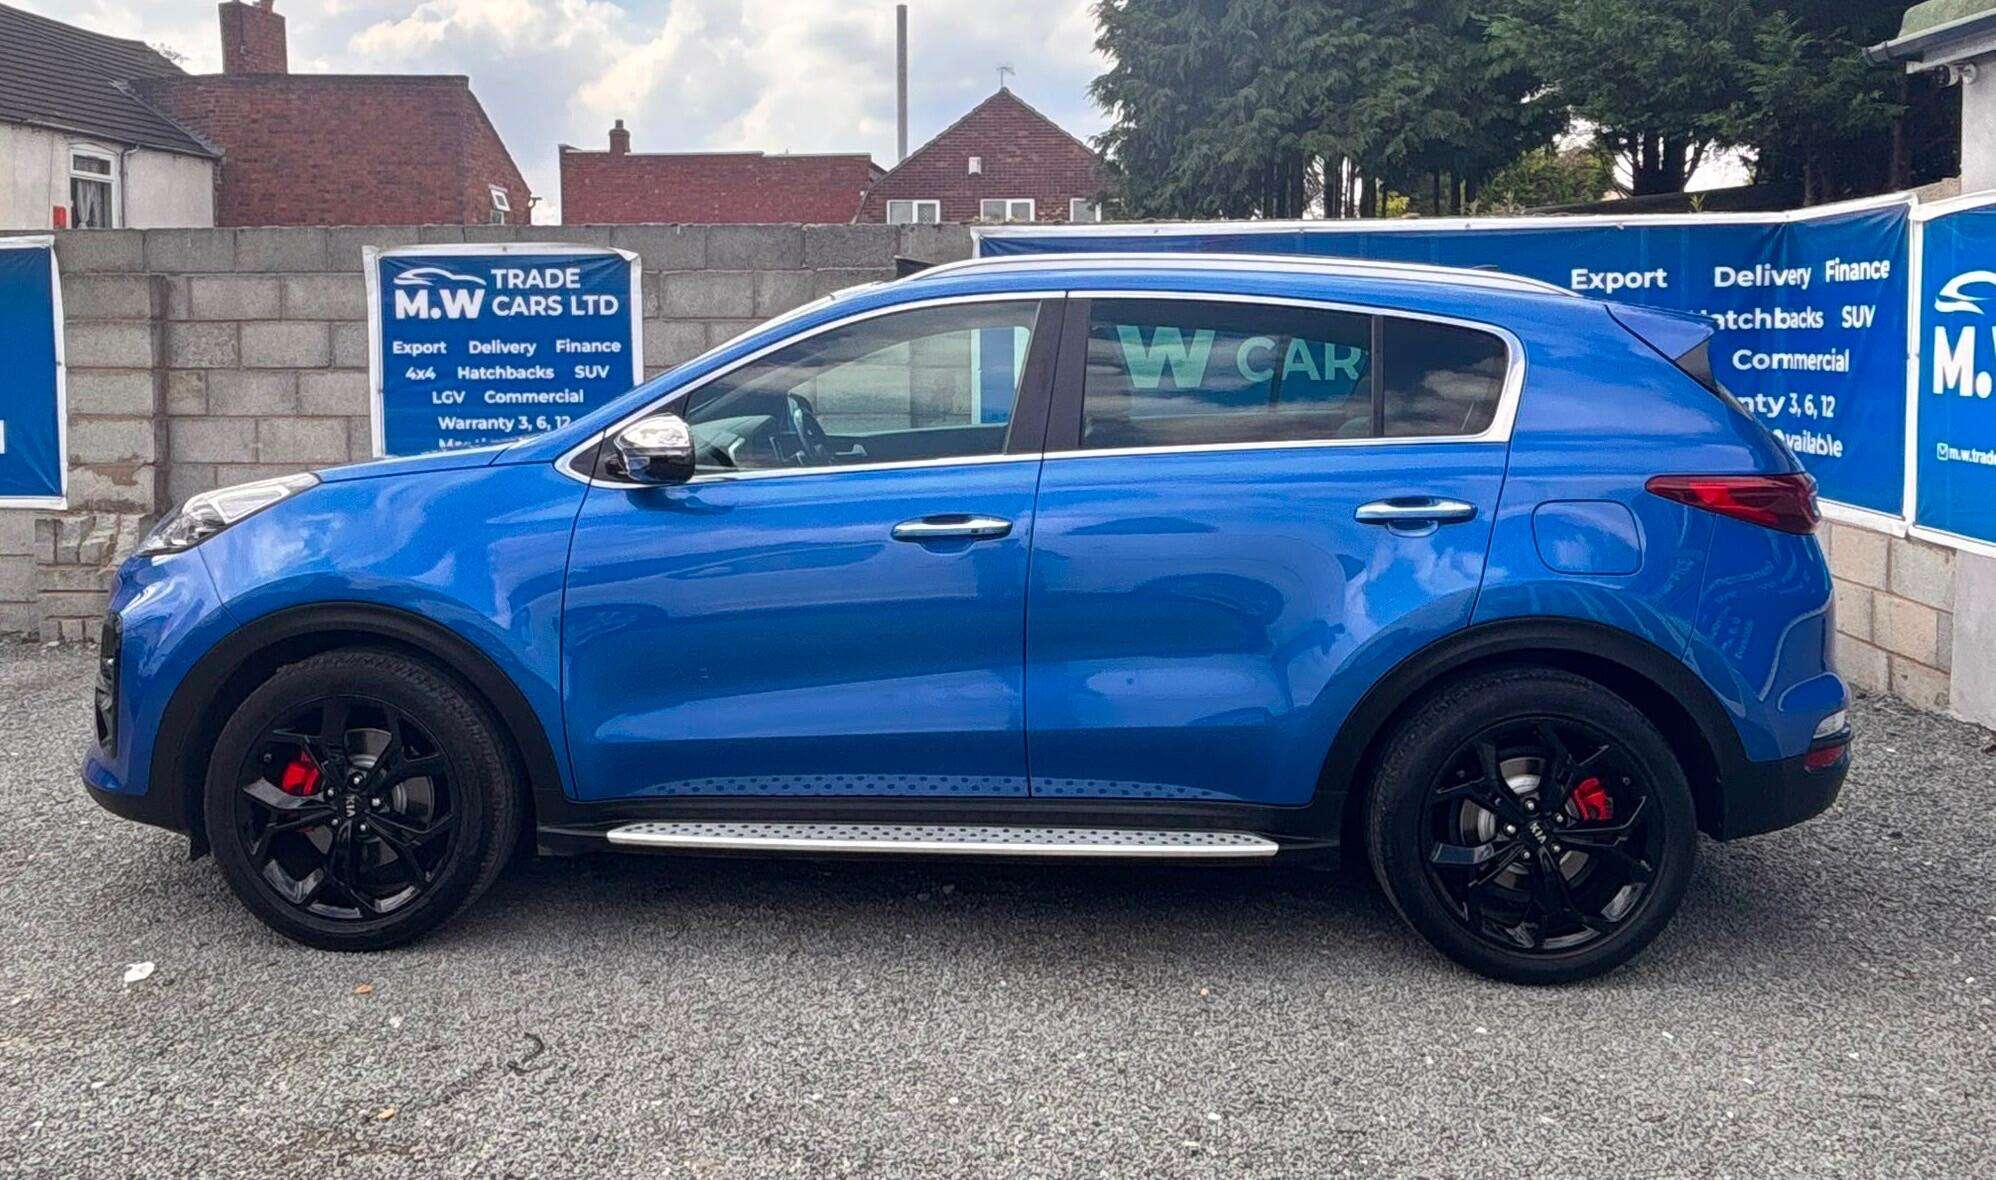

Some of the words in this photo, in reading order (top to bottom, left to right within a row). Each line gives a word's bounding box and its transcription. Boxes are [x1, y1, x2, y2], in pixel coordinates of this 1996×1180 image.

[490, 268, 581, 289] TRADE
[1571, 267, 1668, 294] Export
[1714, 263, 1811, 290] Delivery
[1825, 257, 1890, 283] Finance
[394, 289, 486, 320] M.W
[492, 296, 563, 317] CARS
[570, 295, 619, 316] LTD
[1700, 306, 1824, 330] atchbacks
[1841, 304, 1876, 328] SUV
[392, 340, 447, 357] Export
[468, 339, 537, 357] Delivery
[555, 338, 622, 353] Finance
[1732, 348, 1850, 372] Commercial
[405, 366, 436, 381] 4x4
[457, 366, 555, 380] Hatchbacks
[574, 365, 610, 378] SUV
[432, 391, 465, 405] LGV
[484, 389, 584, 404] Commercial
[1820, 395, 1836, 418] 12
[438, 416, 515, 432] Warranty
[518, 416, 533, 431] 3,
[536, 416, 552, 431] 6,
